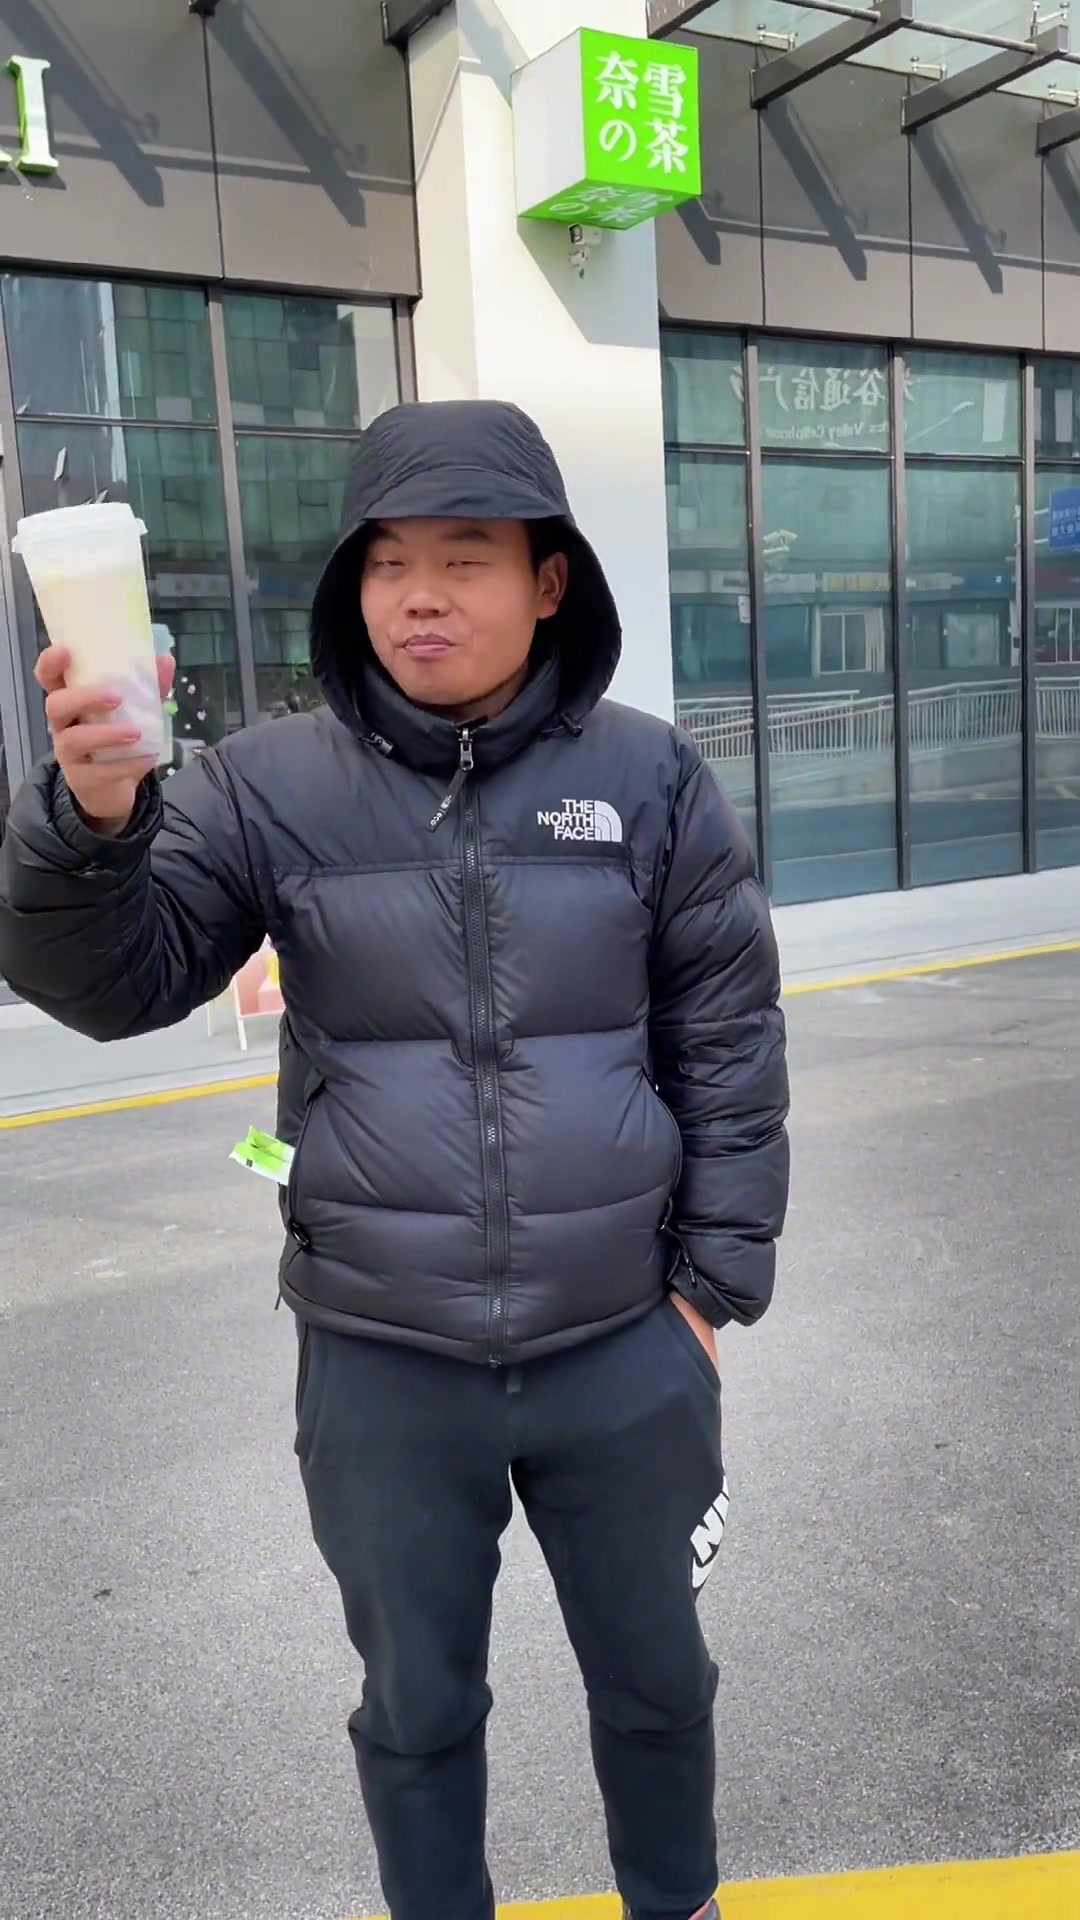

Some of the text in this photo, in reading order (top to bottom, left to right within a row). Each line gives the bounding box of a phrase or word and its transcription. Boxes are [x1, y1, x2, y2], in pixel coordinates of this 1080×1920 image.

[596, 50, 687, 119] 奈雪
[598, 118, 689, 174] の茶
[562, 799, 594, 813] THE
[537, 811, 594, 827] NORTH
[554, 826, 595, 841] FACE
